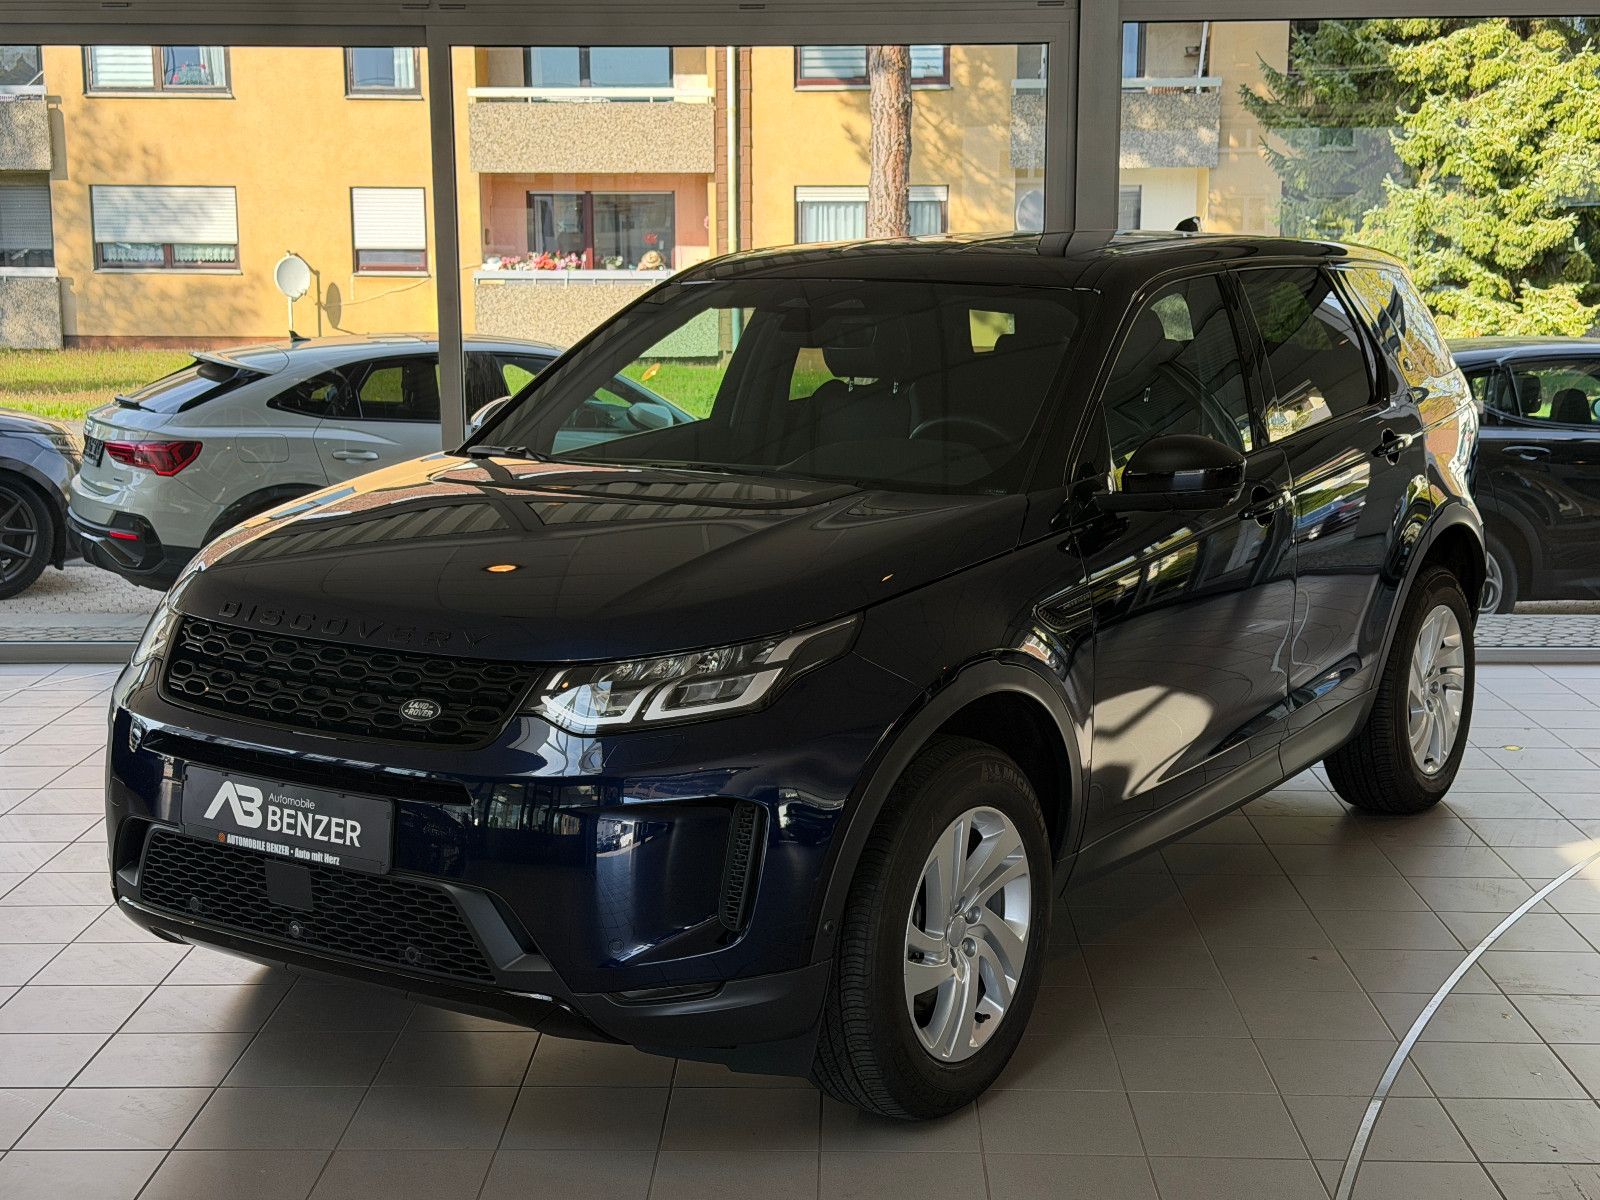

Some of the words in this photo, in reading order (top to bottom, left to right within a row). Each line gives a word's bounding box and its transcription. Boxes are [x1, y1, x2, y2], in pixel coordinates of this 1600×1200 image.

[218, 600, 496, 649] DISCOVERY
[268, 792, 316, 810] Automobile
[266, 805, 362, 848] BENZER
[226, 833, 266, 852] AUTOMOBILE
[266, 842, 290, 856] BENZER
[294, 847, 311, 860] Auto
[311, 851, 324, 862] mit
[324, 853, 340, 866] Herz
